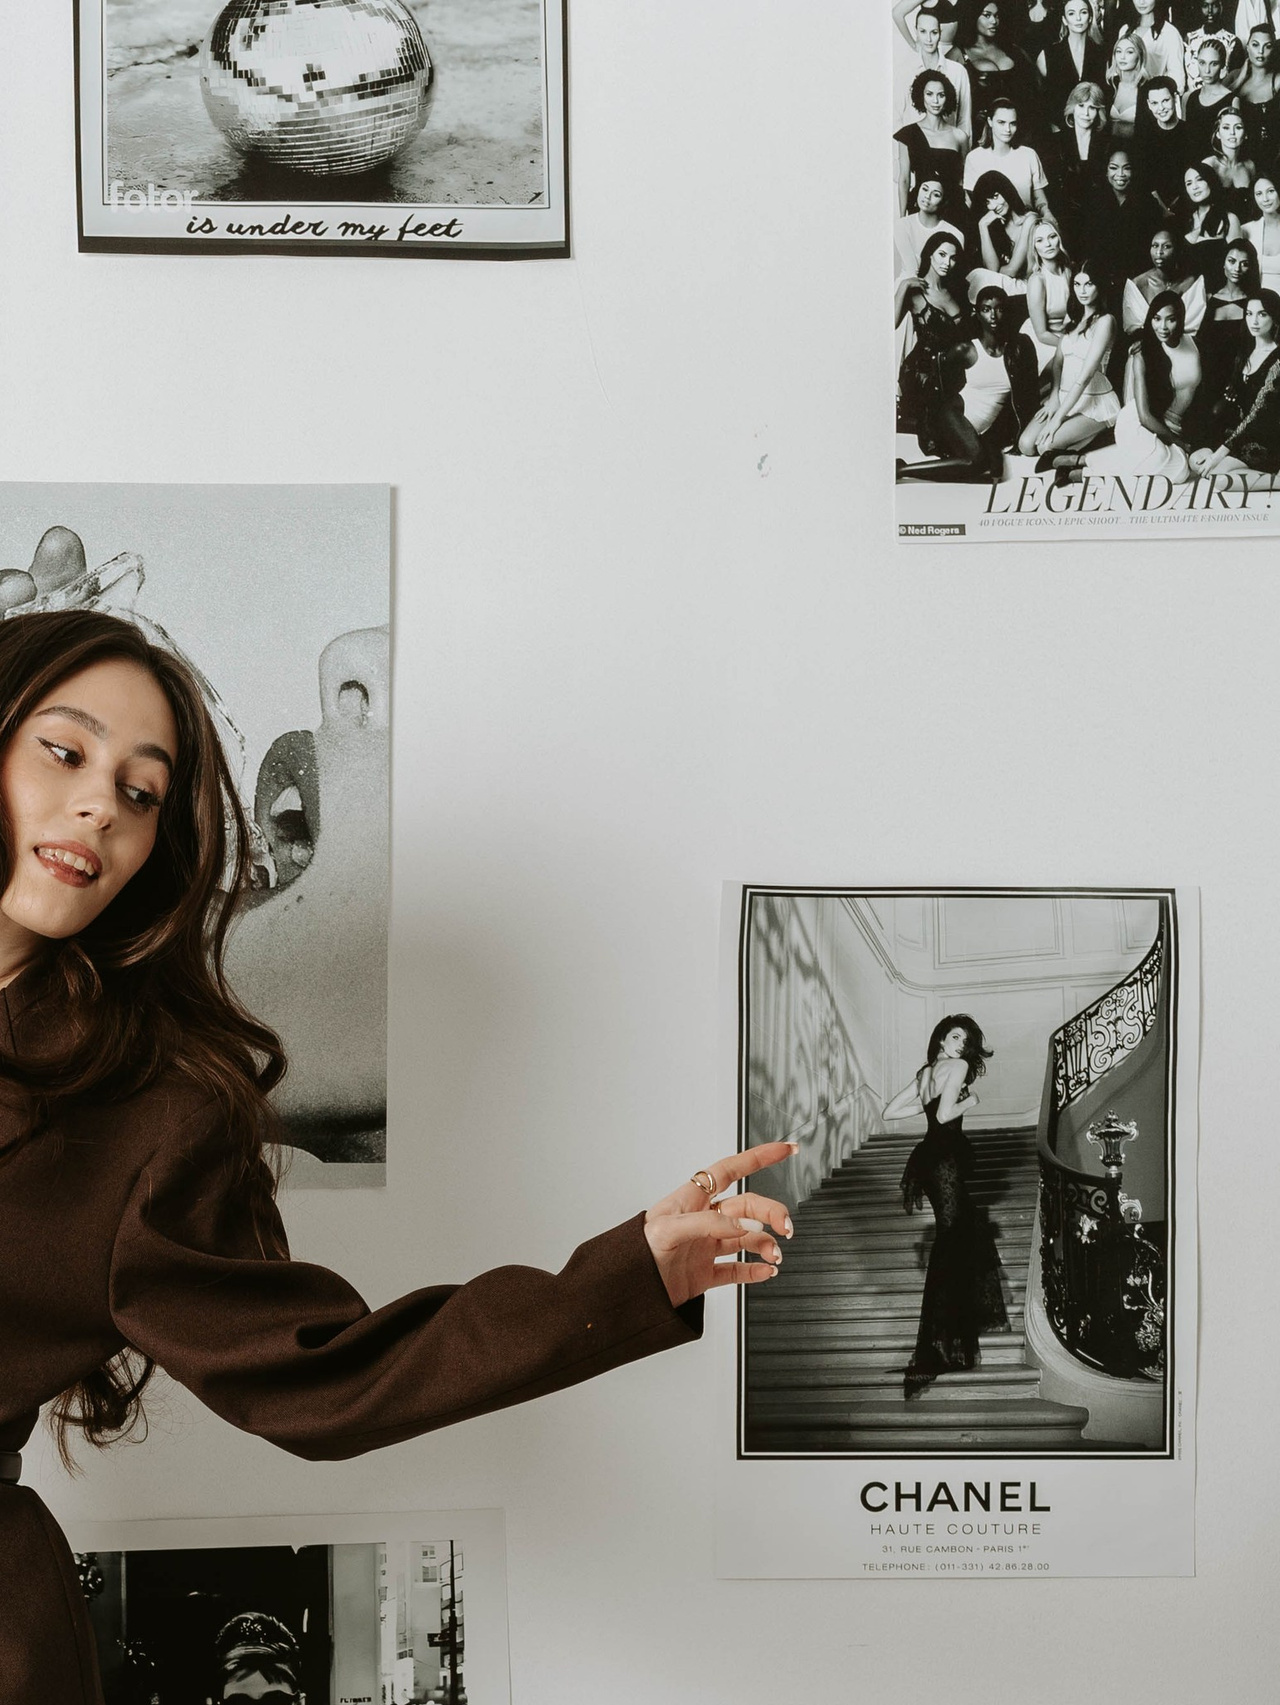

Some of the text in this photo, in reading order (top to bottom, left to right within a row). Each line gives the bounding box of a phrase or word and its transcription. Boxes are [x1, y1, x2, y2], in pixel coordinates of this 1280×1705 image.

[109, 179, 199, 214] fotor
[186, 213, 464, 241] is under my feet
[983, 473, 1277, 514] LEGENDARY!
[1064, 517, 1086, 525] EPIC
[1129, 516, 1148, 524] THE
[1150, 515, 1198, 523] ULTIMATE
[1200, 514, 1242, 522] FASHION
[1242, 513, 1270, 522] ISSUE
[907, 525, 926, 535] Ned
[927, 525, 960, 537] Rogers
[860, 1481, 1051, 1513] CHANEL
[870, 1523, 1042, 1535] HAUTE COUTURE
[901, 1545, 922, 1553] RUE
[926, 1545, 974, 1553] CAMBON
[983, 1545, 1014, 1553] PARIS
[934, 1562, 985, 1572] (011-331)
